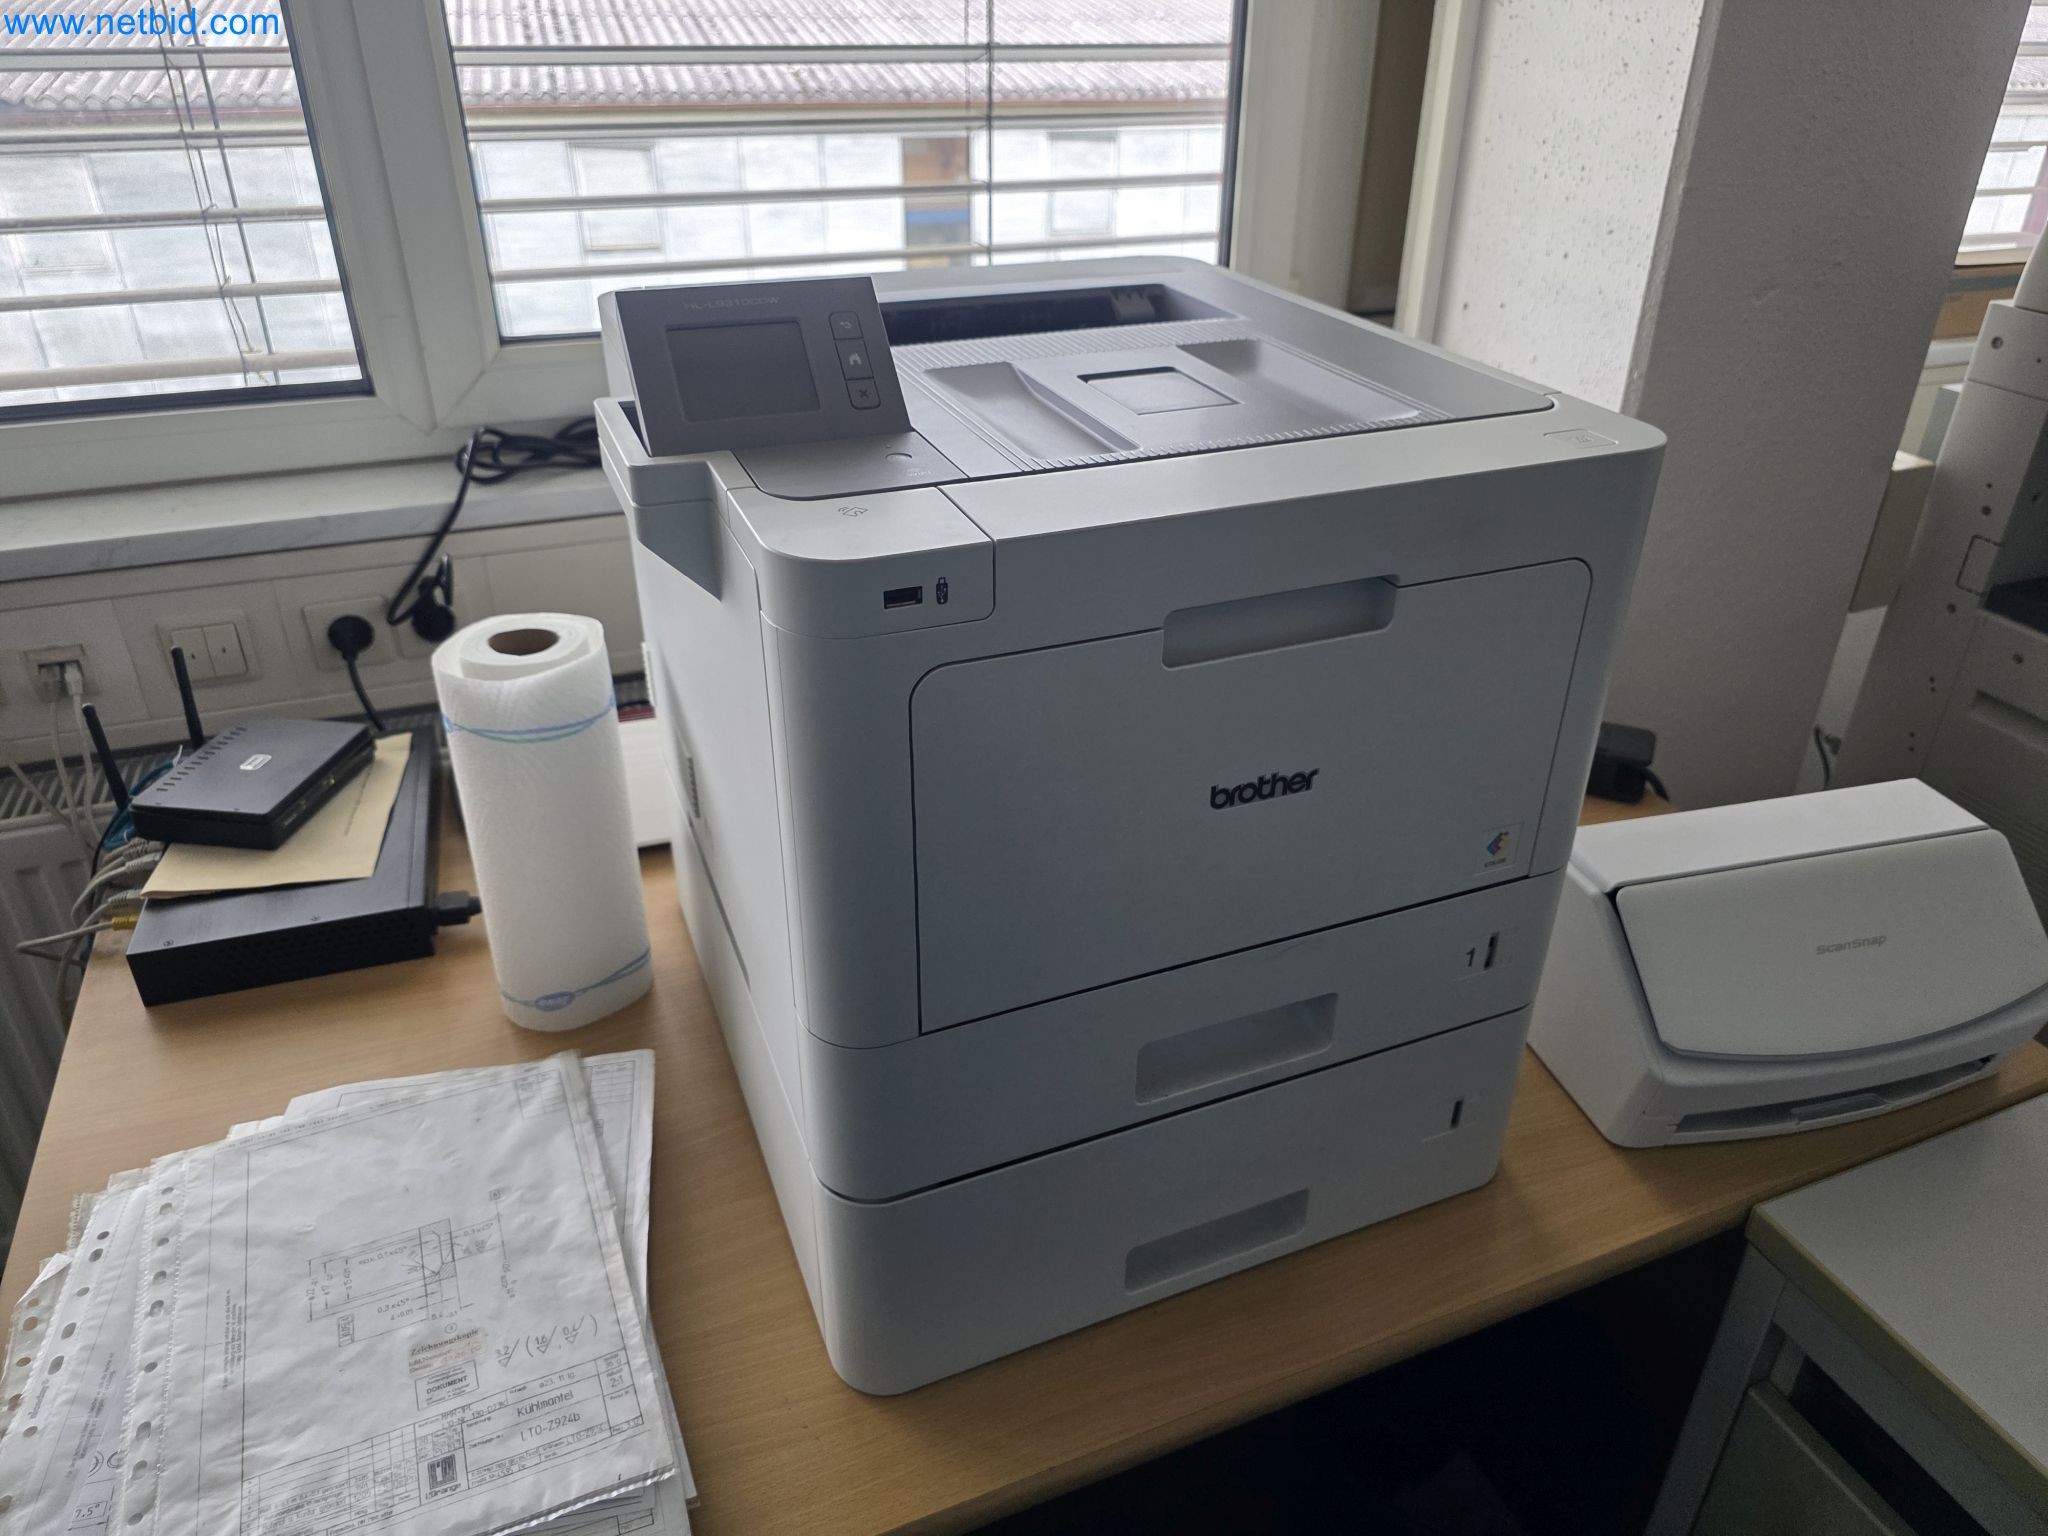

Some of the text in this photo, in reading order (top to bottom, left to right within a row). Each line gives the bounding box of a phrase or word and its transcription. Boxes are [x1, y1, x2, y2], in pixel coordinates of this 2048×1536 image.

[1209, 768, 1319, 810] brother
[1816, 936, 1887, 955] ScanSnap
[1466, 947, 1476, 967] 1
[426, 1375, 468, 1395] DOKUMENT
[517, 1390, 574, 1417] Kühlmantel
